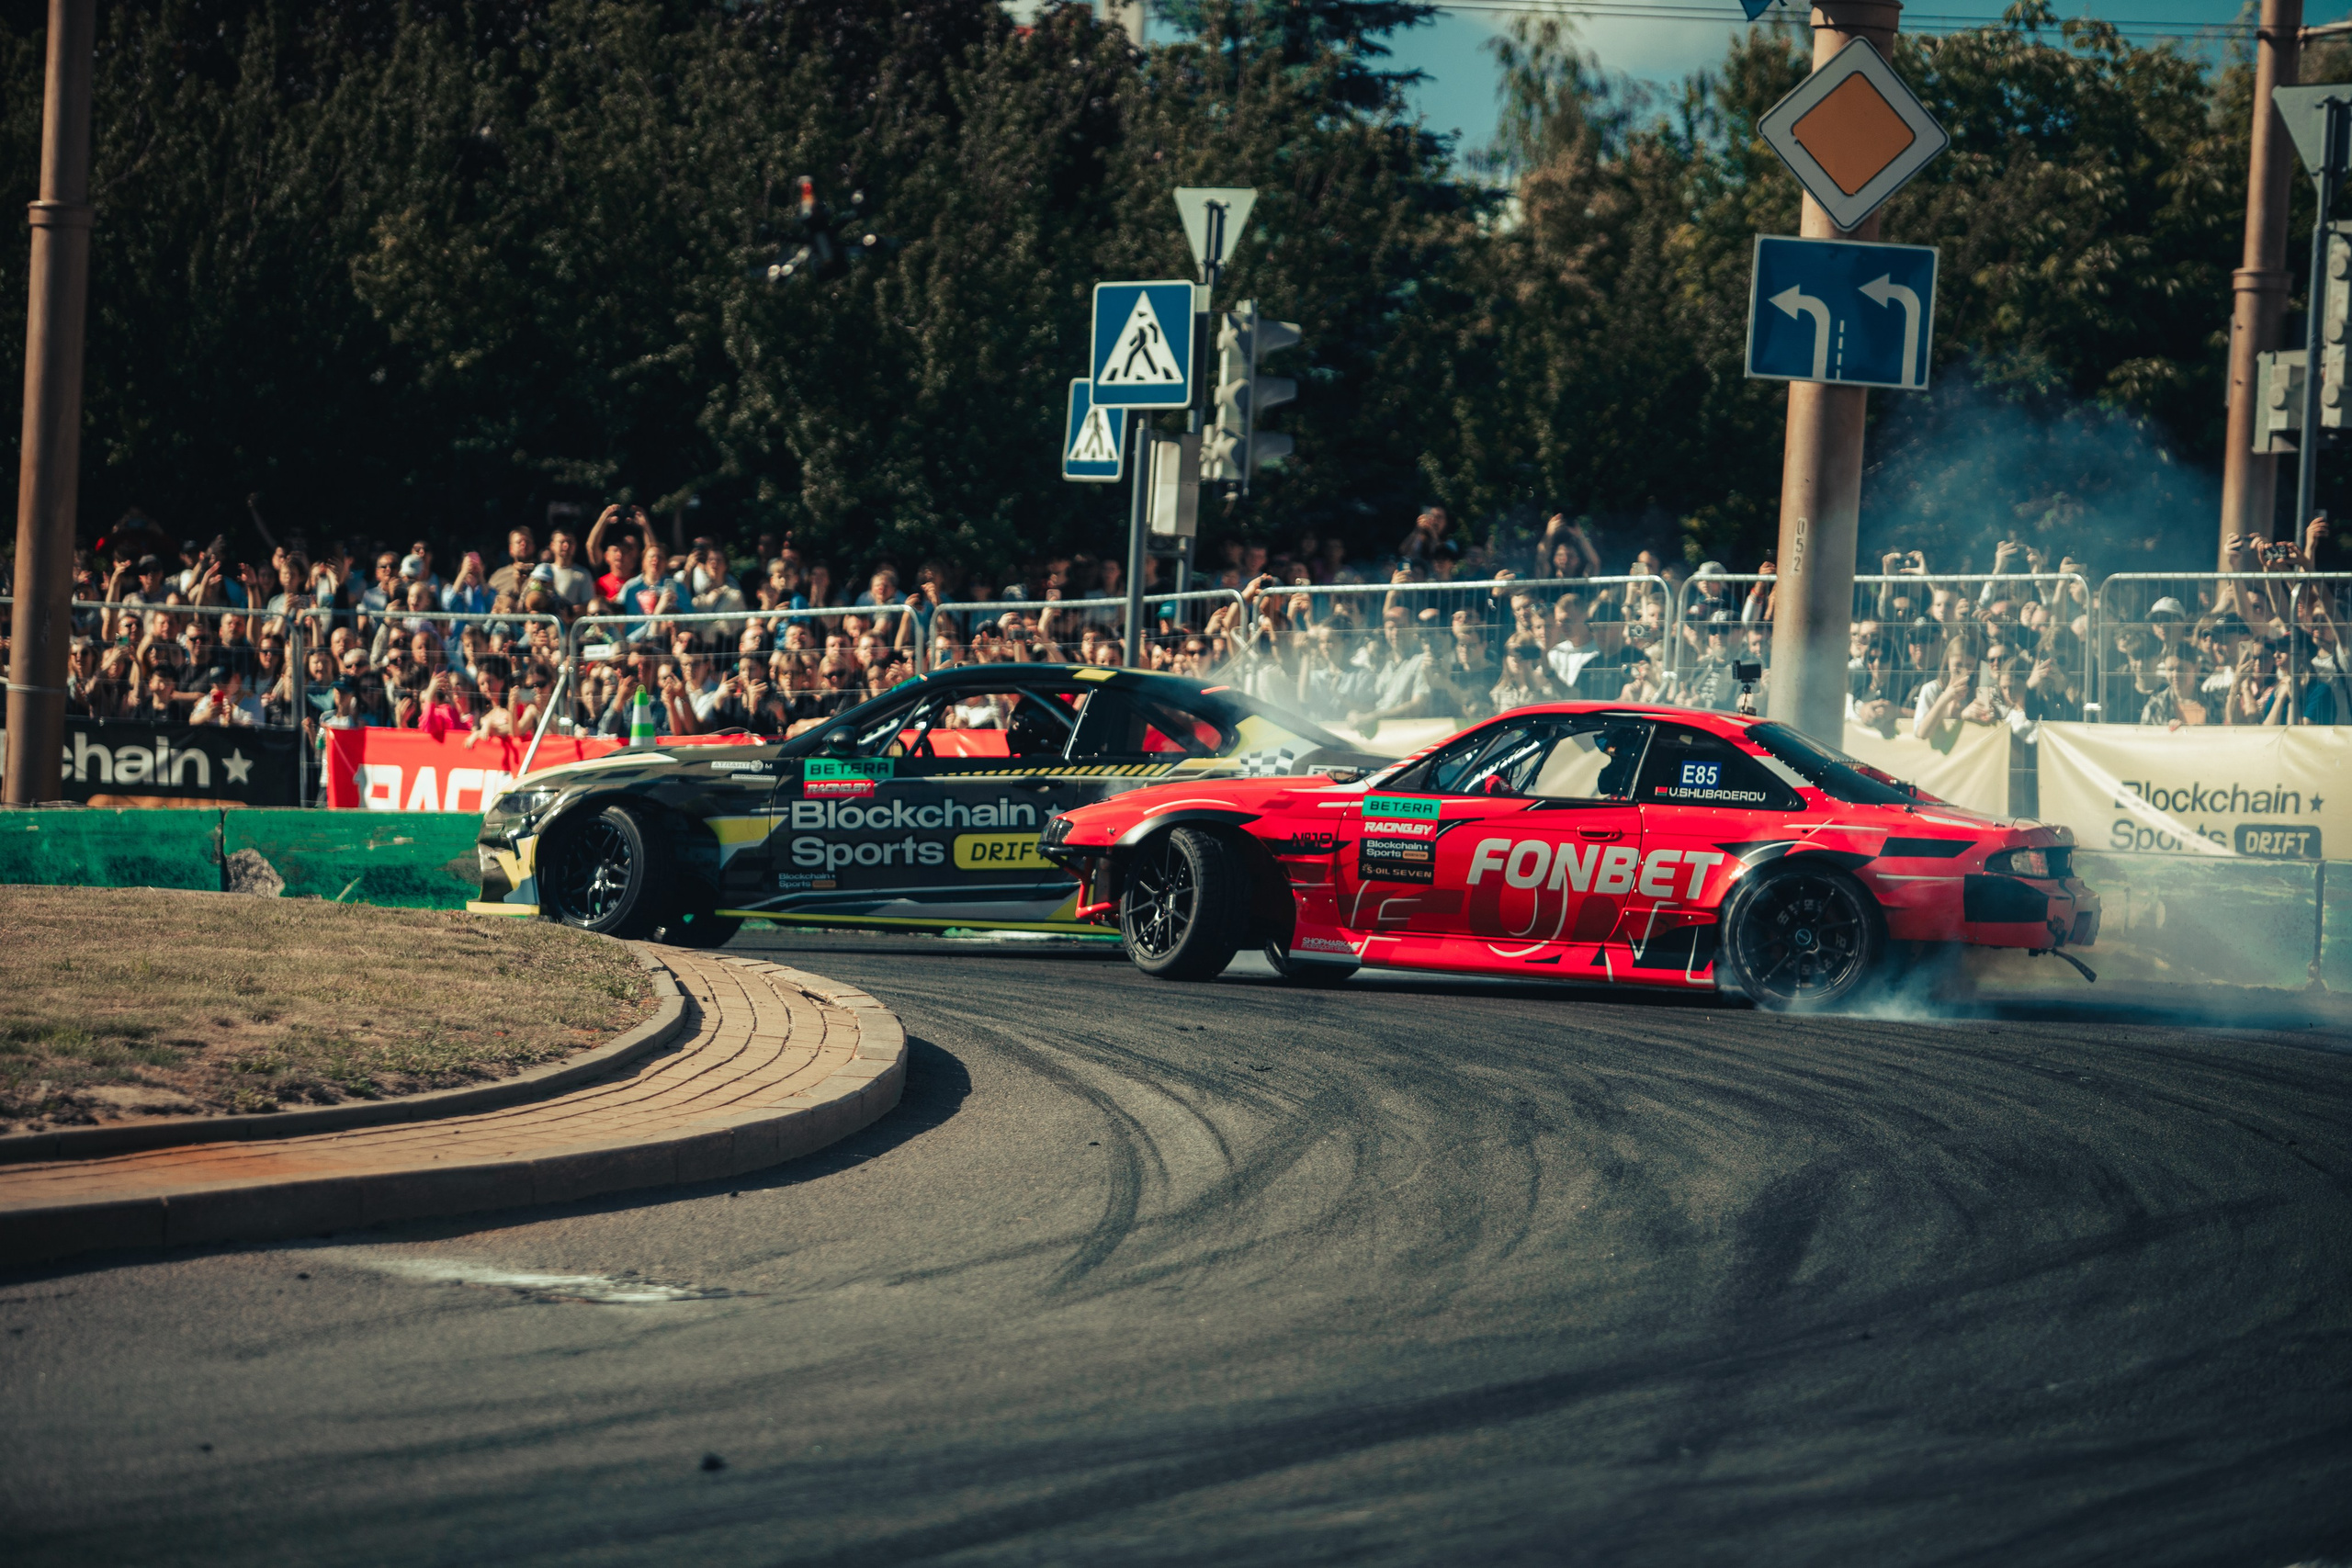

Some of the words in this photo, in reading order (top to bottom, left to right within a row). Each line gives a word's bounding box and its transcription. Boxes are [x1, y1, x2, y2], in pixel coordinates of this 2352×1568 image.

[1681, 764, 1718, 784] E85
[791, 797, 1035, 829] Blockchain
[1364, 822, 1433, 835] RACING.BY
[1366, 840, 1422, 850] Blockchain
[2245, 831, 2310, 855] DRIFT
[791, 835, 944, 871] Sports
[1367, 849, 1401, 857] Sports
[1393, 869, 1432, 878] SEVEN
[1466, 838, 1724, 900] FONBET
[778, 880, 811, 888] Sports
